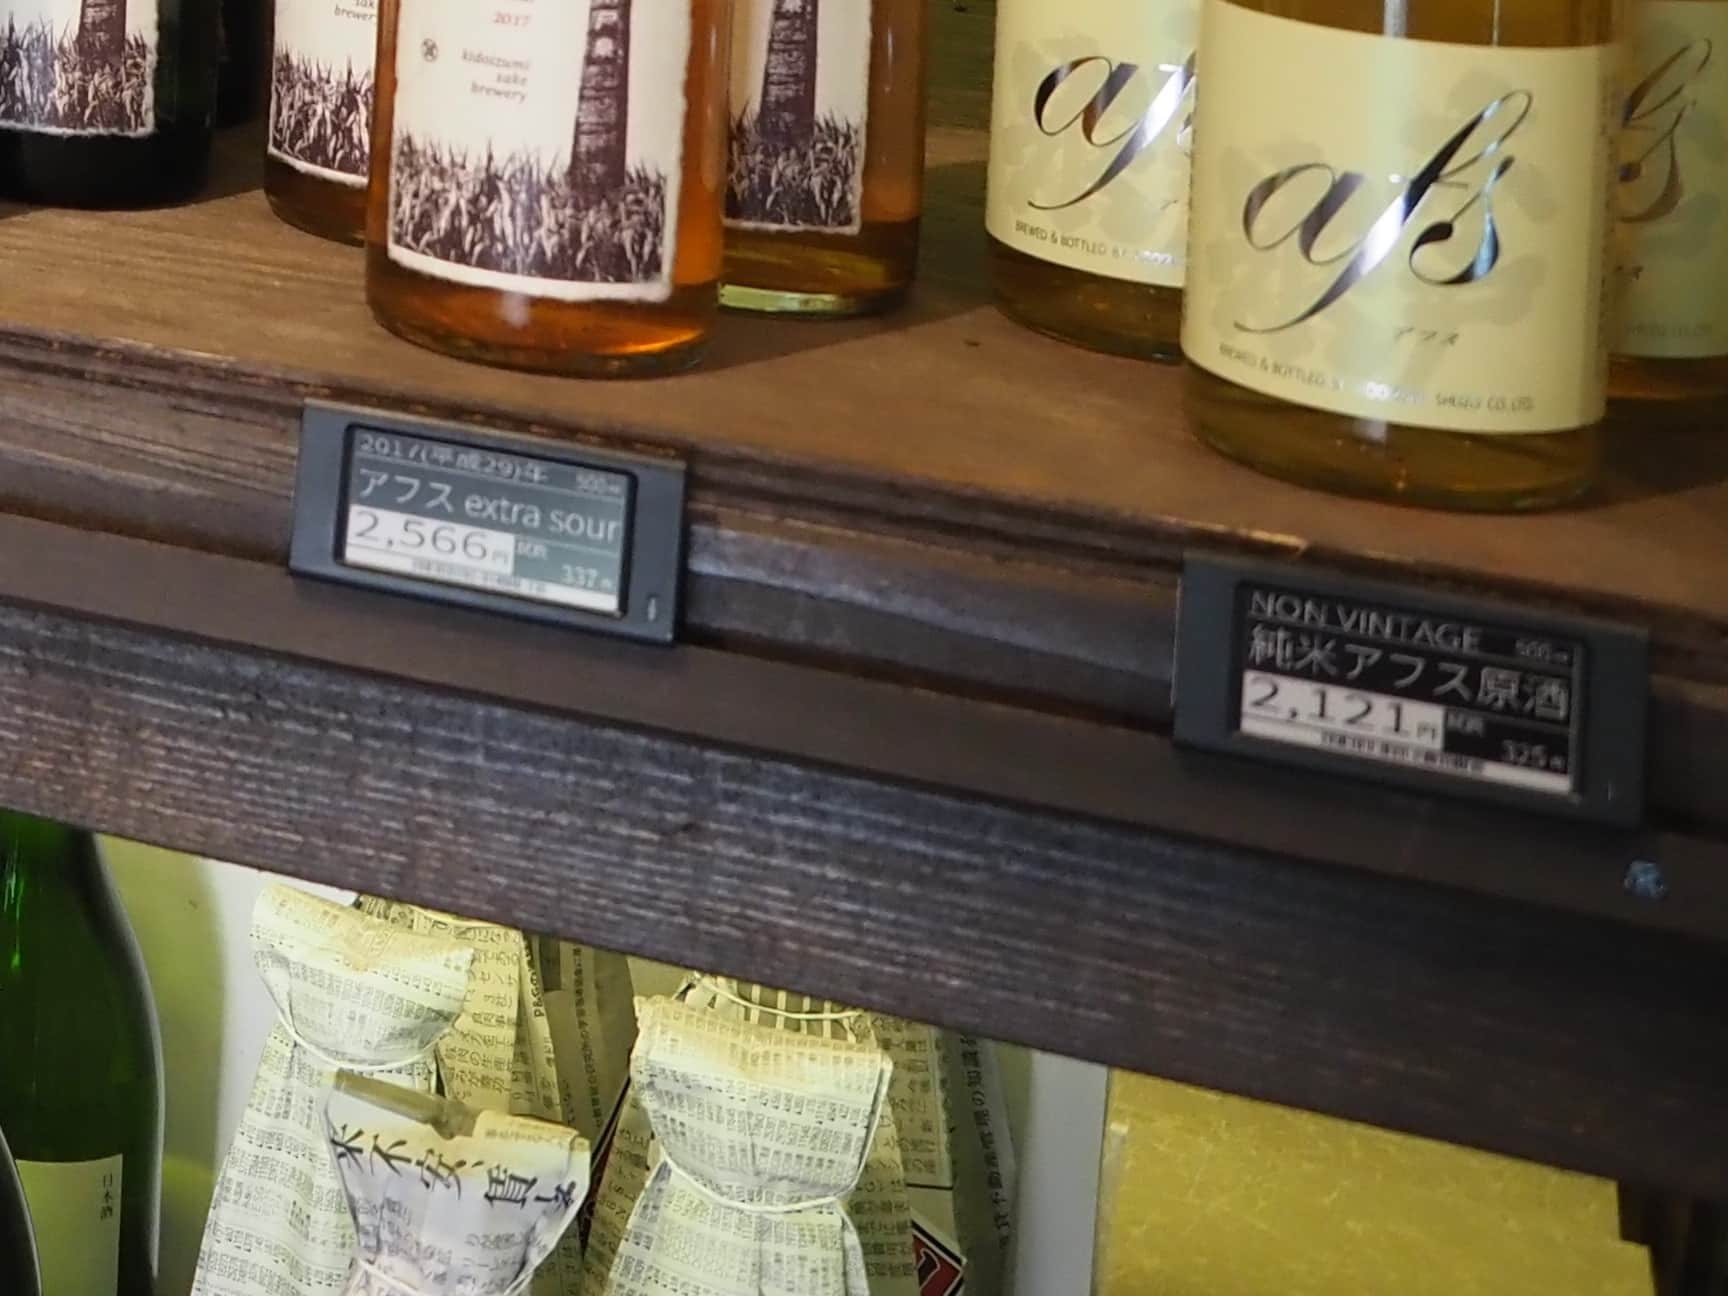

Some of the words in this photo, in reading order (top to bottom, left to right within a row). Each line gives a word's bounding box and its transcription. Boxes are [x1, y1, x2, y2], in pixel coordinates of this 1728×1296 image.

[493, 10, 530, 28] 2017
[470, 82, 528, 105] brewery
[1233, 90, 1534, 334] afs
[359, 467, 454, 514] アフス
[464, 493, 542, 530] extra
[549, 509, 621, 543] sour
[354, 512, 509, 567] 2,566円
[1250, 589, 1326, 626] NON
[1338, 606, 1484, 656] VINTAGE
[1248, 622, 1569, 723] 純米アフス原酒
[1248, 675, 1440, 744] 2,121円
